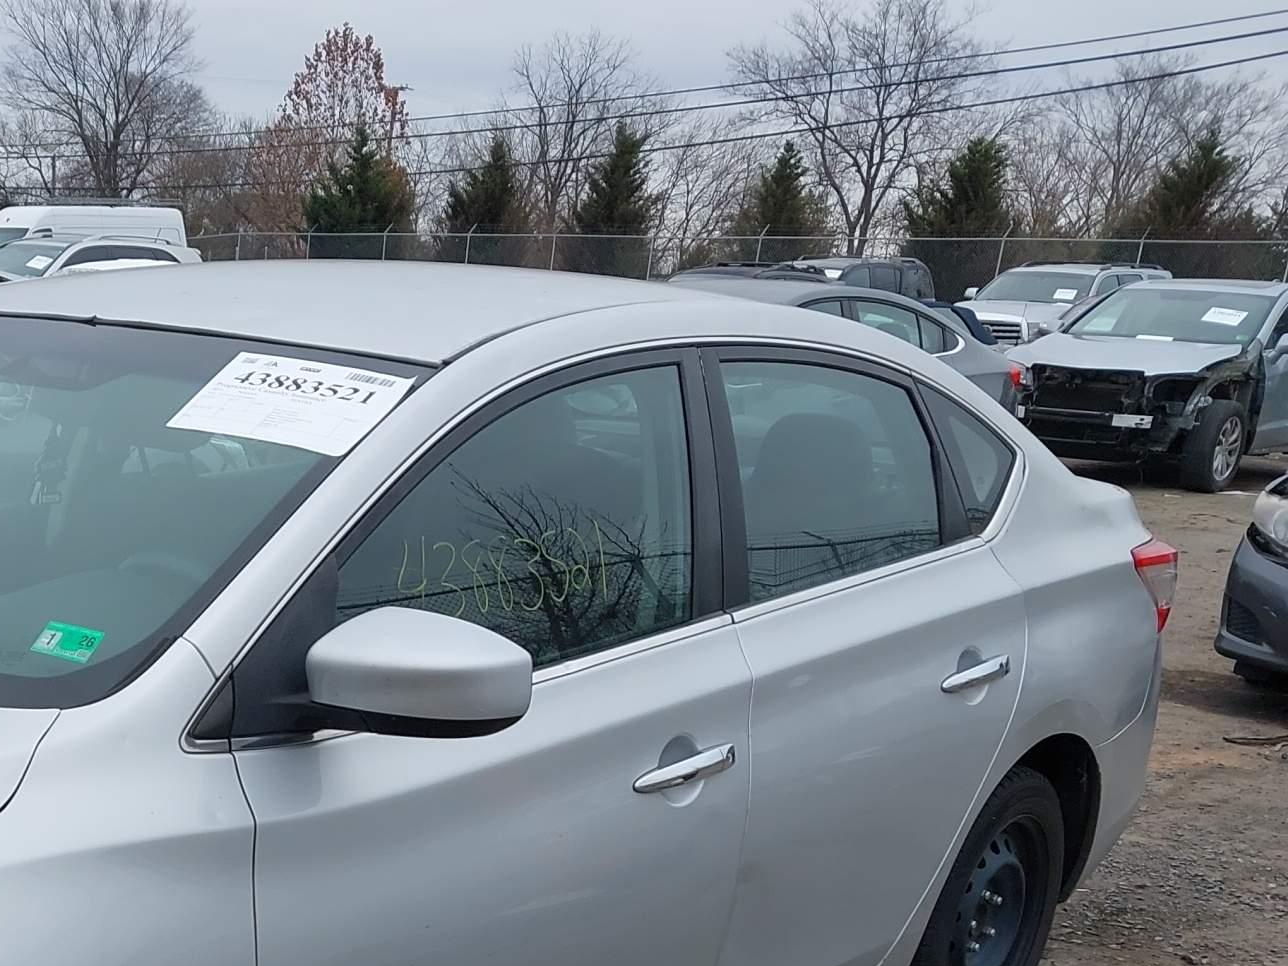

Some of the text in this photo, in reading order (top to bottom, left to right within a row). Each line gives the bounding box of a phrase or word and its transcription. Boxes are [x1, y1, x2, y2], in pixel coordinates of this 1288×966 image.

[233, 370, 377, 404] 43883521
[397, 519, 608, 617] 43883521
[78, 635, 97, 648] 26
